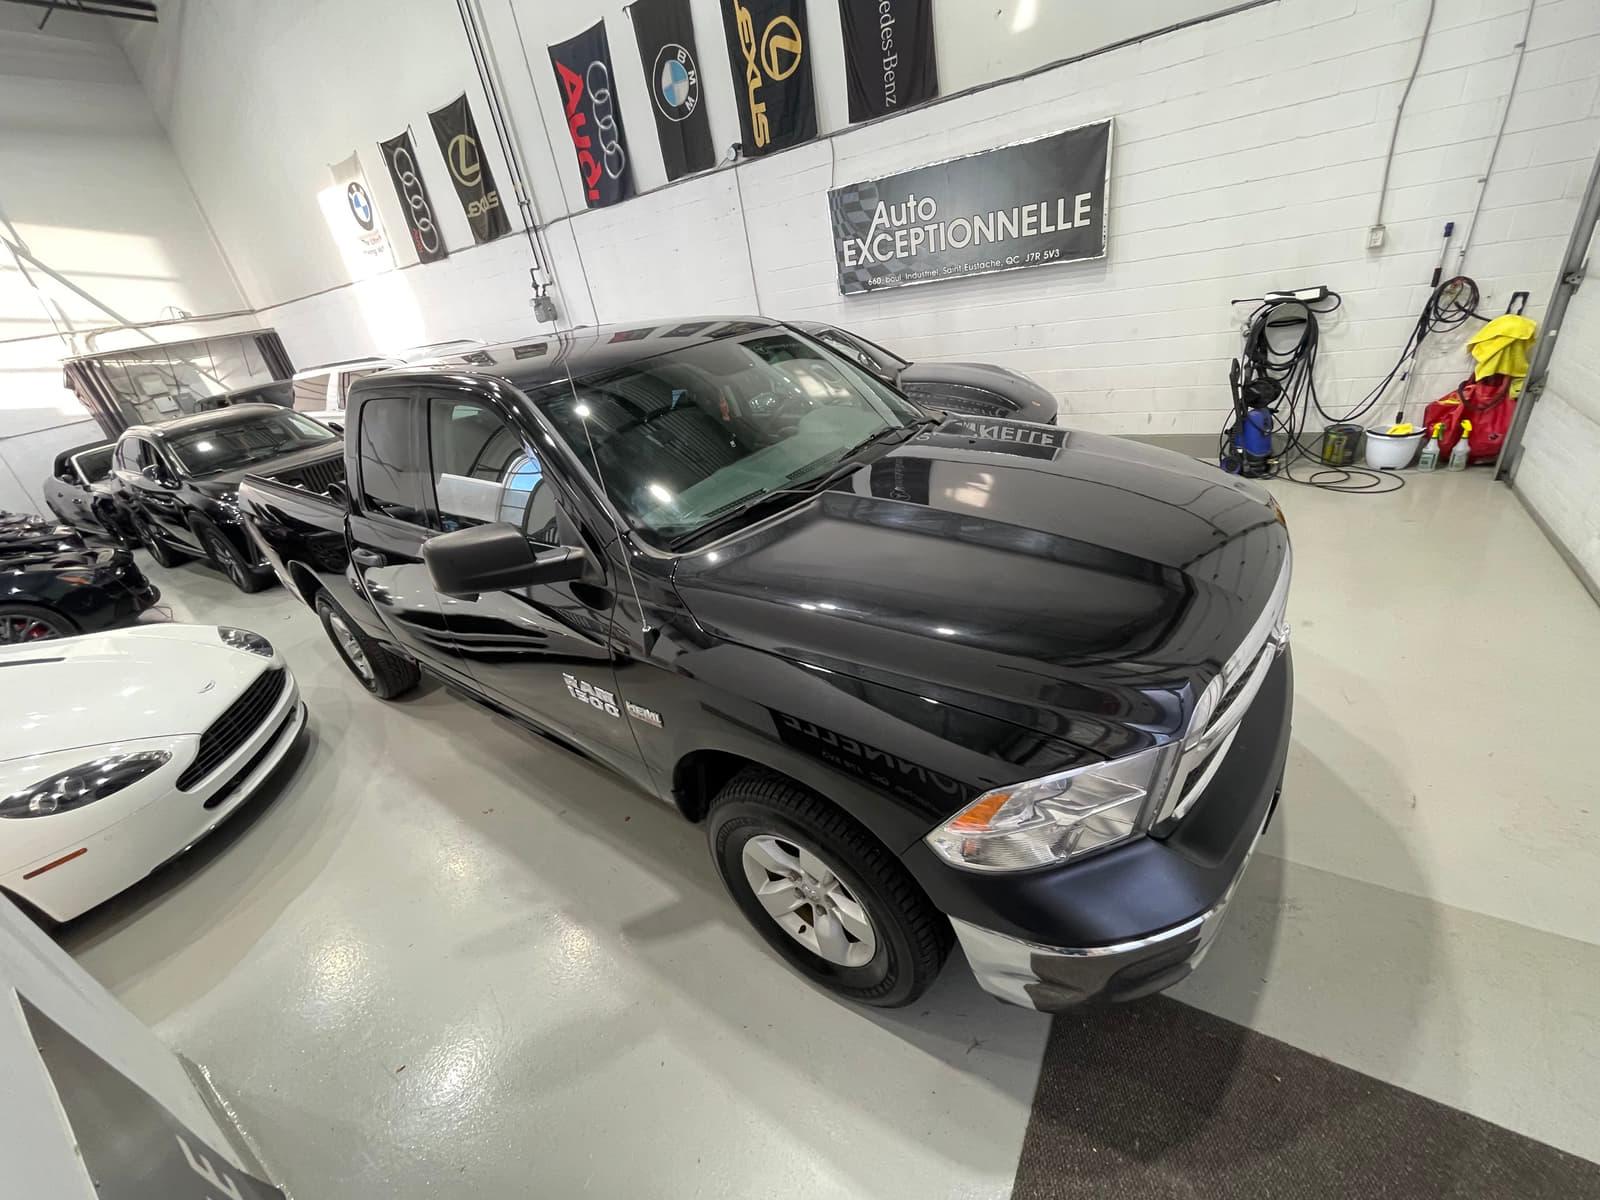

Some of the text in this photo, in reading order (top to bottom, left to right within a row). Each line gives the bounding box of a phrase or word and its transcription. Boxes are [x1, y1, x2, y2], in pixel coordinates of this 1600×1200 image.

[734, 0, 771, 148] EXUS
[879, 0, 898, 107] edes-Benz
[843, 192, 1092, 267] EXCEPTIONNELLE
[868, 194, 937, 231] Auto
[1005, 255, 1020, 265] QC
